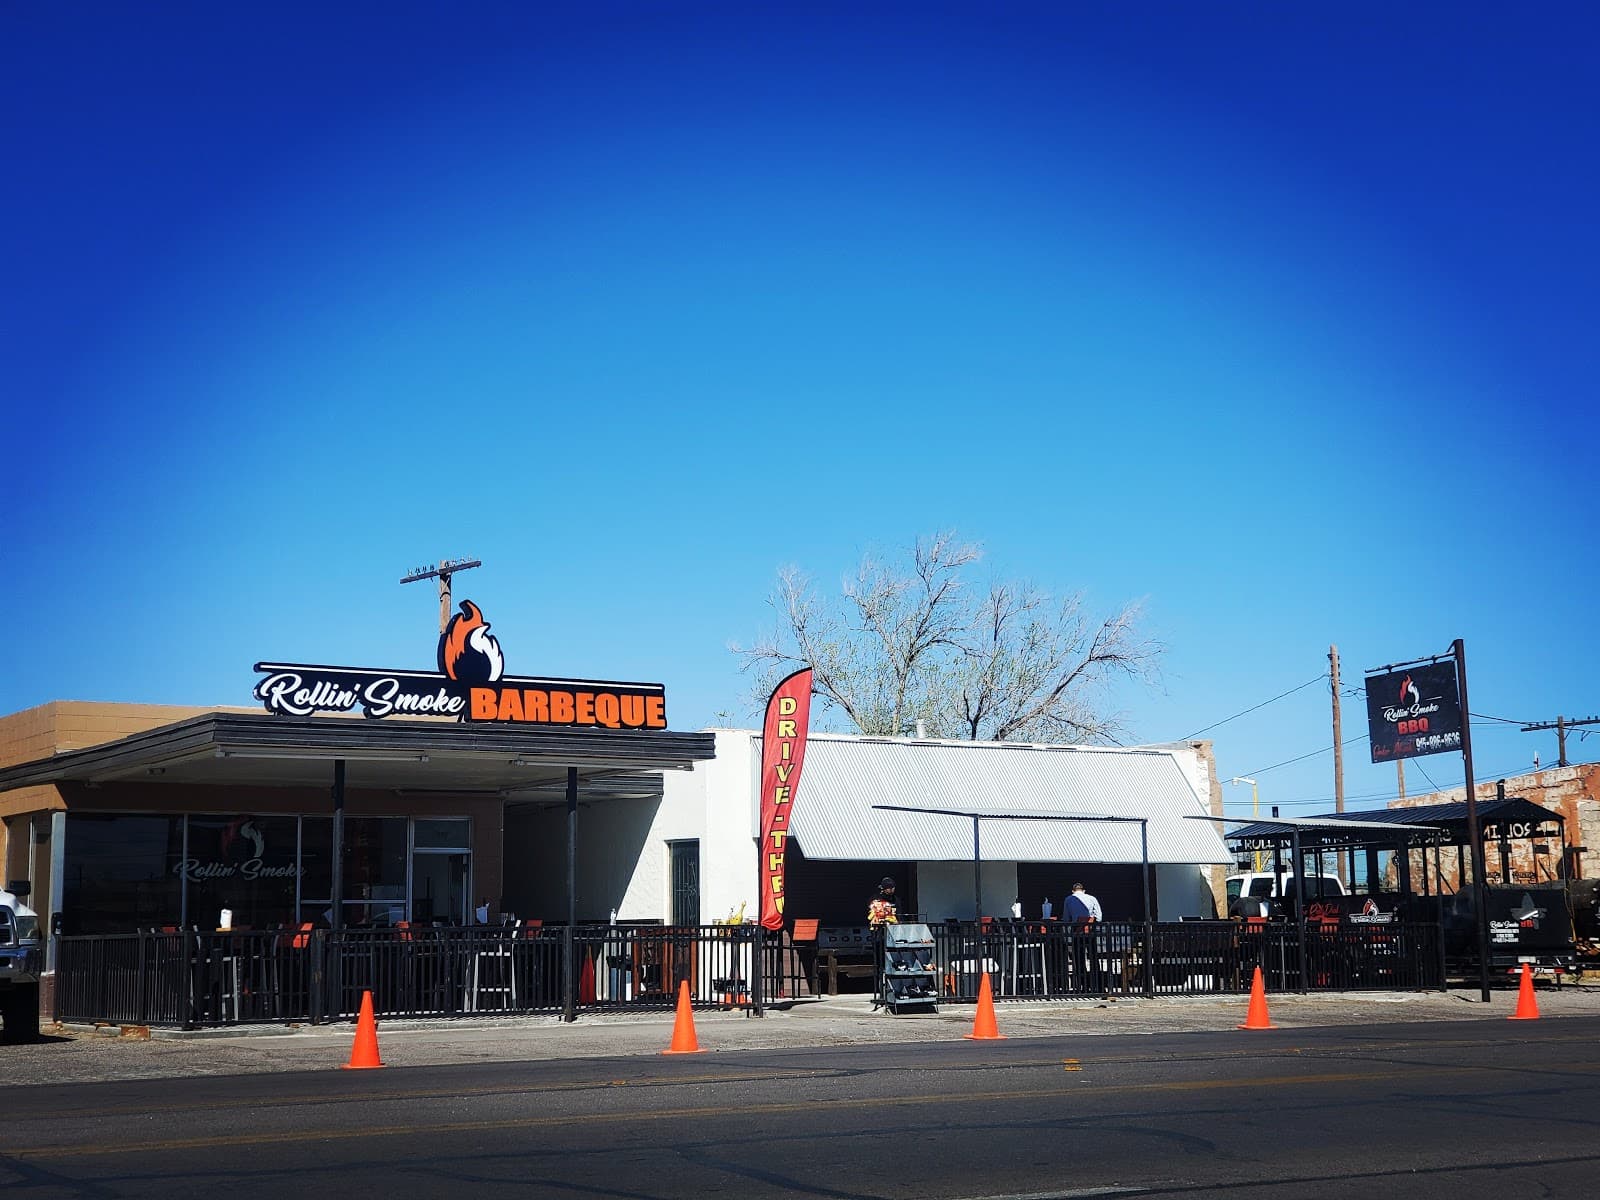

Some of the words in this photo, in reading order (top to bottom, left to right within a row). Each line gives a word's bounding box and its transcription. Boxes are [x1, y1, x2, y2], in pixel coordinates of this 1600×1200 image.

[259, 673, 361, 716] Rollin'
[363, 678, 466, 717] Smoke
[470, 687, 666, 729] BARBEQUE
[1409, 702, 1440, 718] Smoke
[1397, 717, 1430, 736] BBQ
[173, 858, 238, 882] Rollin'
[239, 858, 307, 883] Smoke
